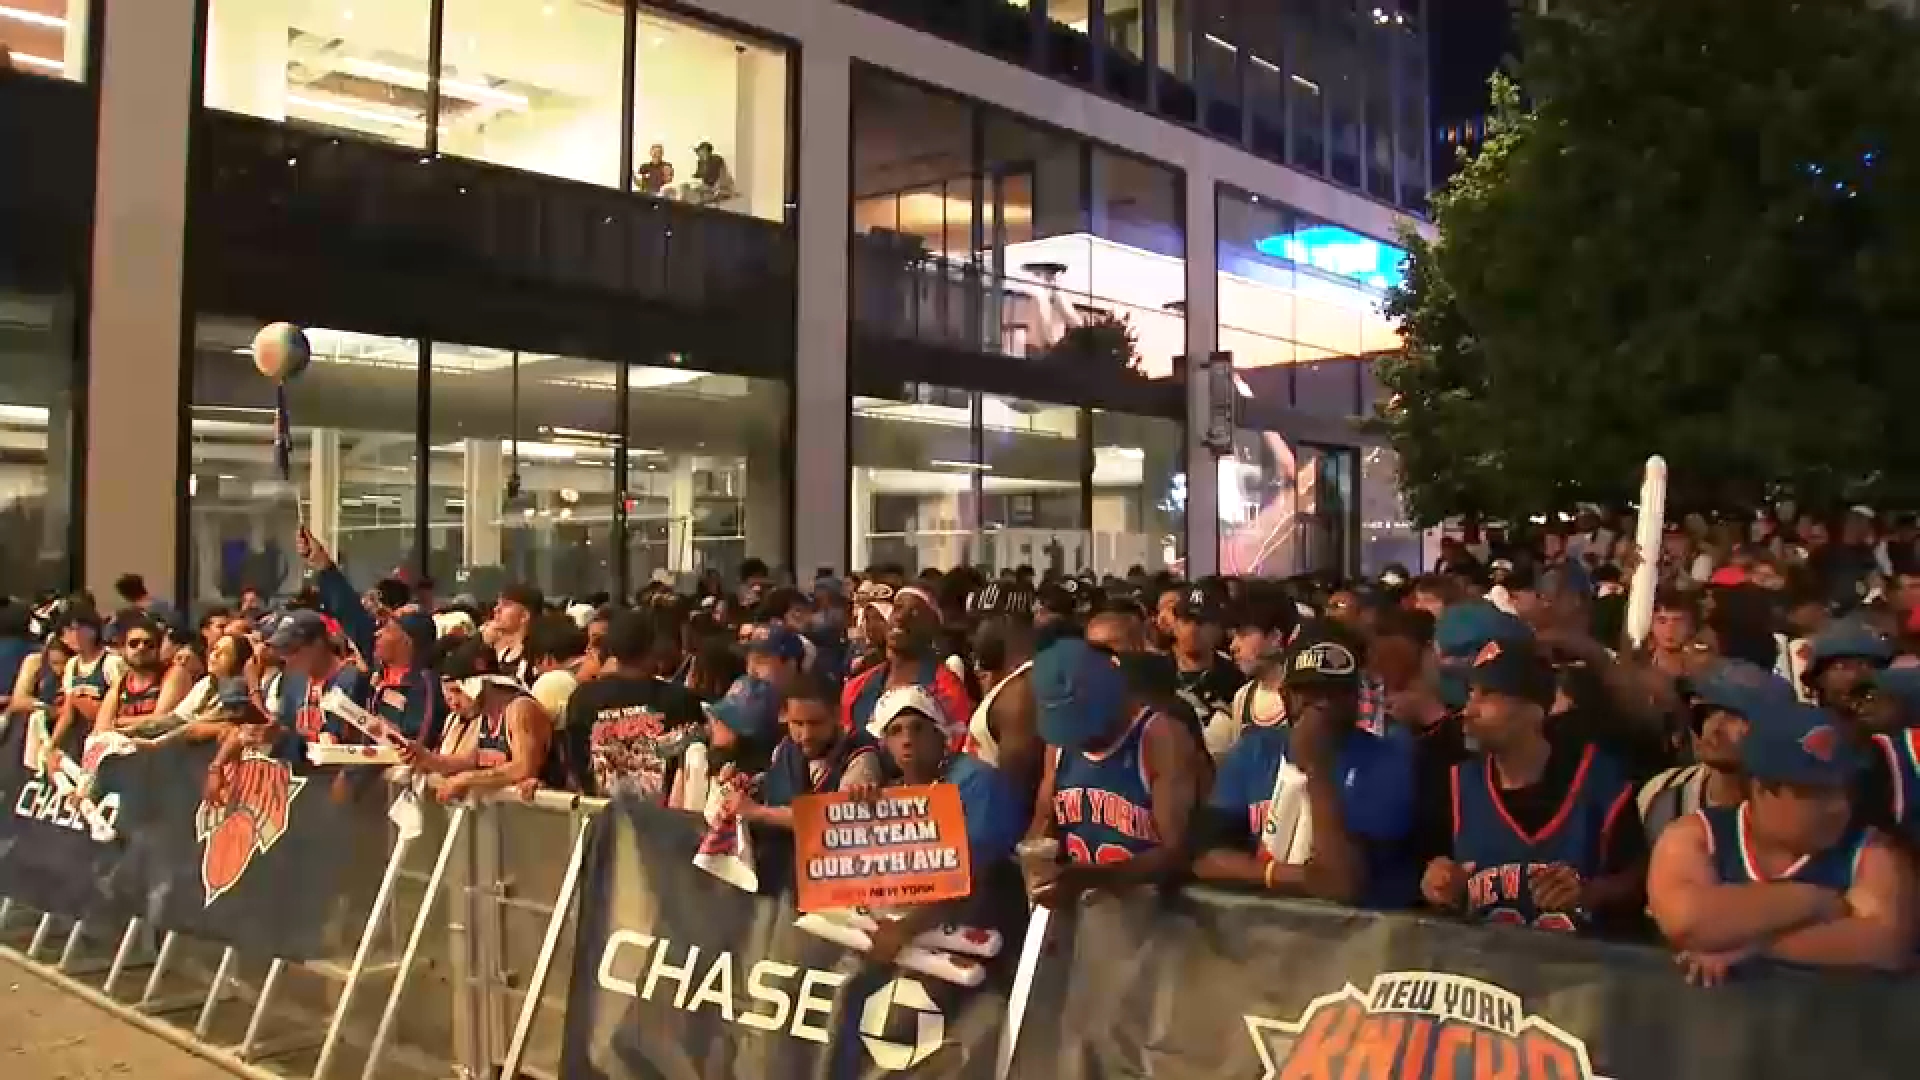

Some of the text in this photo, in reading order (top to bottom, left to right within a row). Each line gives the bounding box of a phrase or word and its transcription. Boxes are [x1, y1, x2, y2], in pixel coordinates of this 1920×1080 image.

[827, 796, 930, 823] OUR CITY
[1054, 788, 1083, 825] EW
[823, 820, 940, 849] OUR TEAM
[808, 847, 960, 879] OUR 7TH AVE
[870, 886, 898, 897] NEW
[901, 884, 935, 895] YORK
[1468, 864, 1521, 908] NEW
[597, 928, 849, 1043] CHASE
[1371, 980, 1515, 1034] NEW YORK
